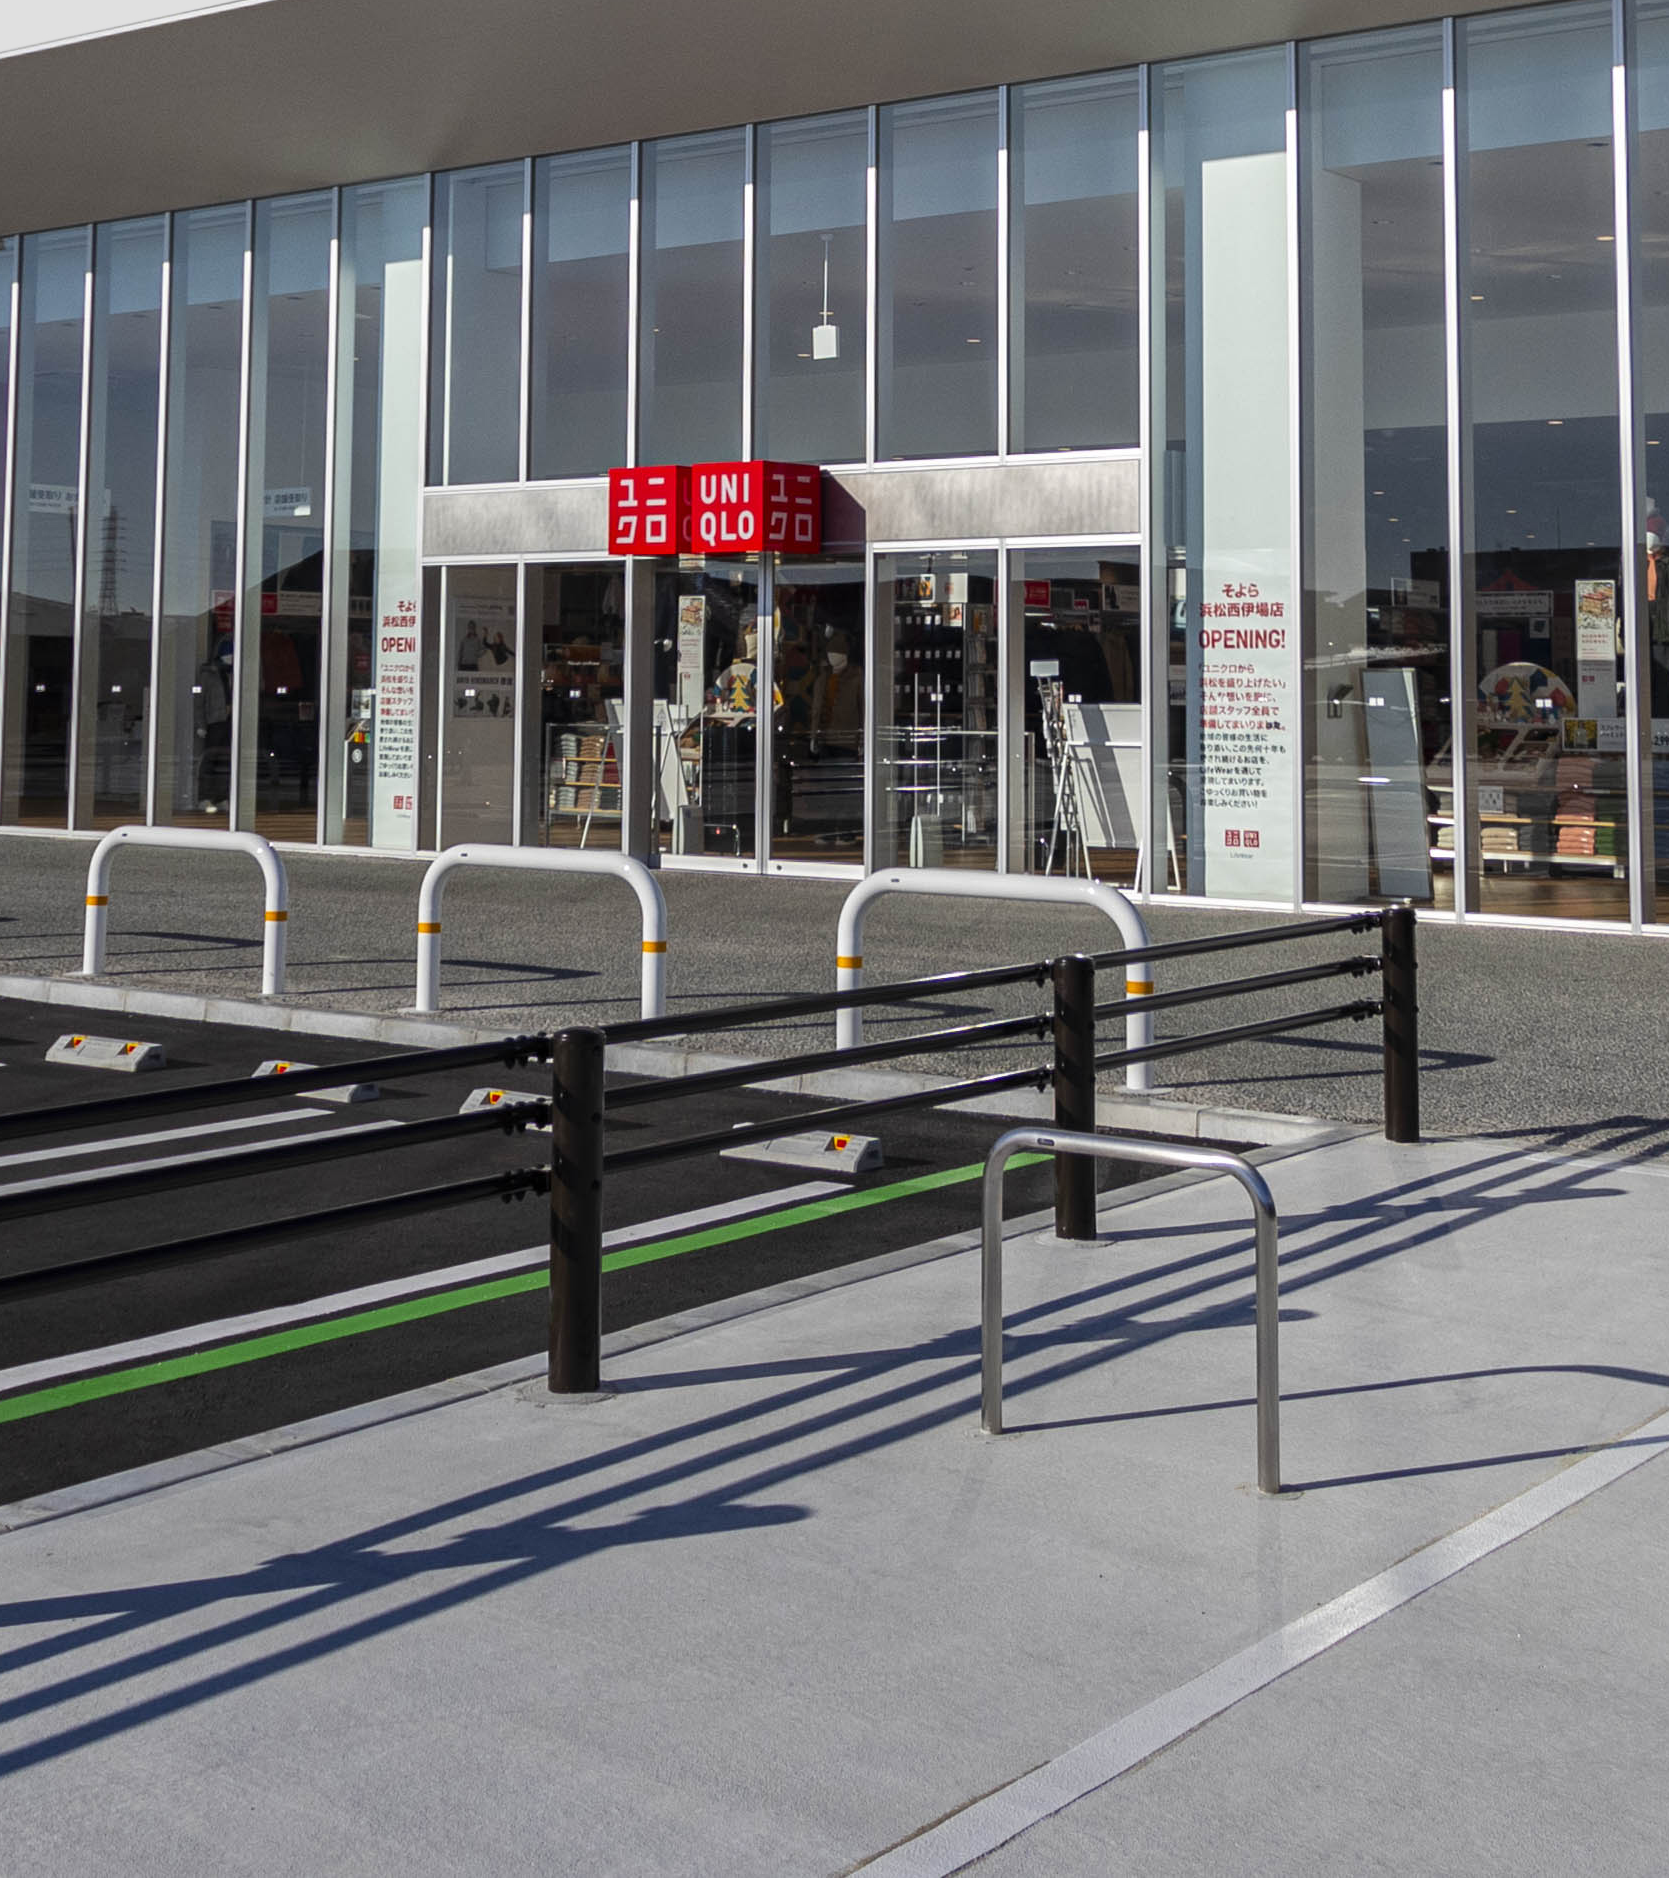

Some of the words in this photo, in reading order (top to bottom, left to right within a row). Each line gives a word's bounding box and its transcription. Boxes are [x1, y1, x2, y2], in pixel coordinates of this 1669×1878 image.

[617, 477, 667, 508] ユニ
[700, 473, 750, 505] UNI
[770, 473, 813, 505] ユニ
[616, 513, 667, 544] クロ
[699, 510, 755, 547] QLO
[769, 511, 813, 542] クロ
[1221, 583, 1260, 598] そよら
[1199, 602, 1285, 618] 浜松西伊場店
[1198, 629, 1286, 649] OPENING!
